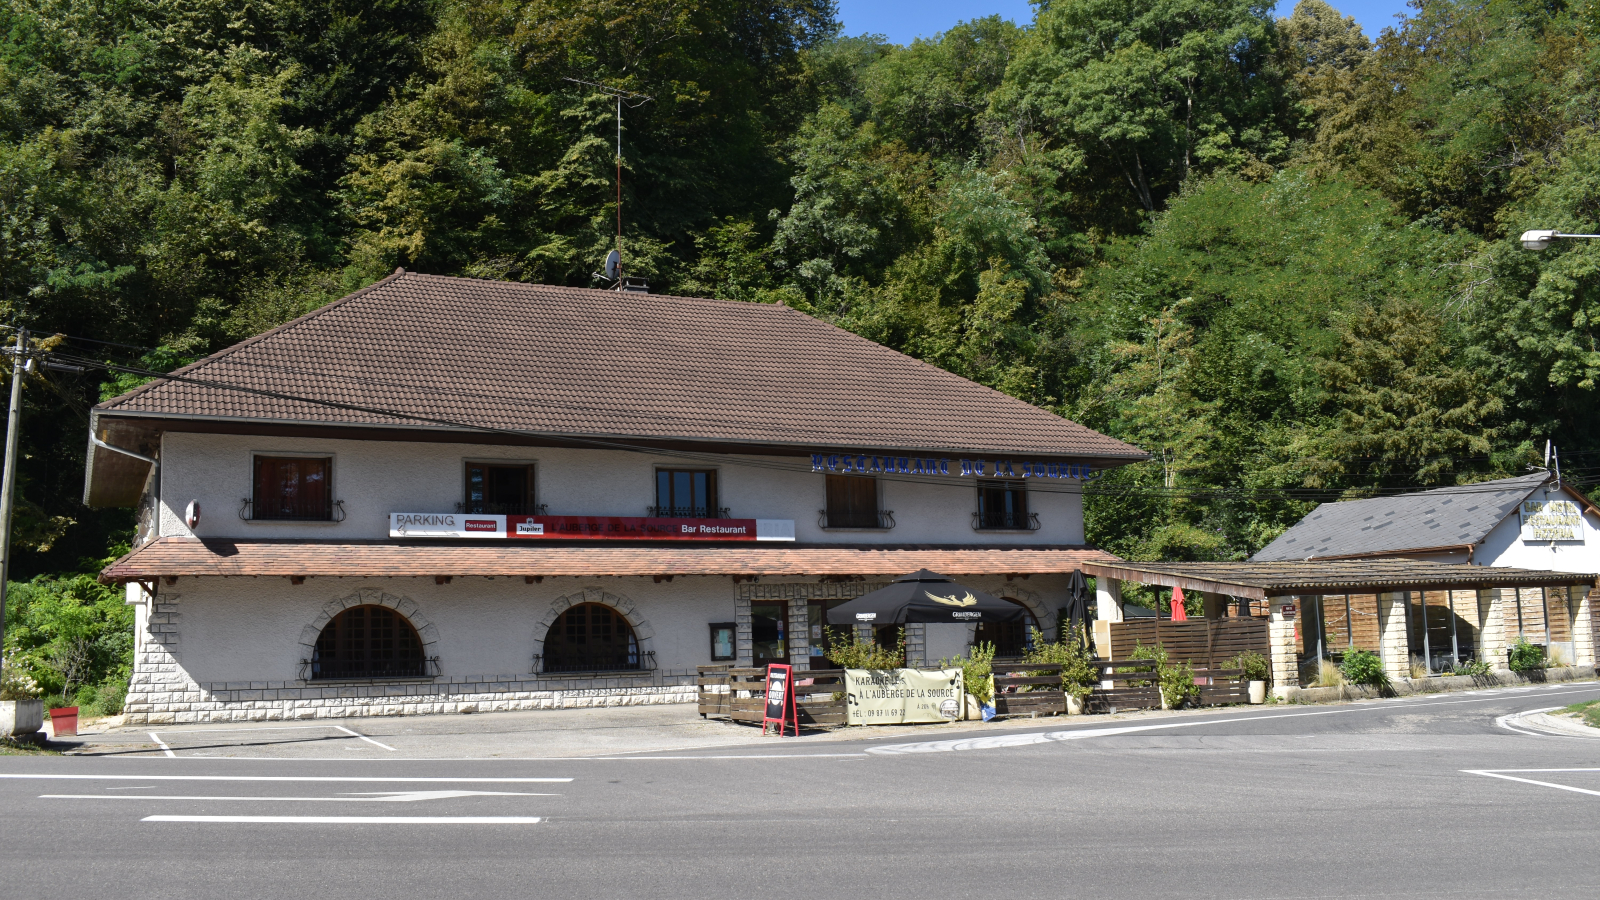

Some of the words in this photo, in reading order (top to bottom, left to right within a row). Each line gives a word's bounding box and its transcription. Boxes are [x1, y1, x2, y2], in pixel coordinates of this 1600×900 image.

[811, 454, 950, 474] RESTAURANT
[960, 459, 985, 476] DE
[993, 460, 1015, 477] LA
[1021, 461, 1091, 480] SOURCE
[1524, 501, 1543, 513] BAR
[396, 514, 456, 526] PARKING
[1522, 514, 1580, 527] RESTAURANT
[465, 522, 497, 530] Restaurant
[519, 525, 542, 533] Jupiler
[551, 523, 603, 532] L'AUBERGE
[607, 523, 620, 532] DE
[624, 524, 636, 532] LA
[640, 524, 678, 533] SOURCE
[681, 524, 697, 533] Bar
[700, 524, 747, 534] Restaurant
[1534, 527, 1575, 539] PIZZERIA
[855, 676, 889, 686] KARAOKE
[865, 688, 905, 699] L'AUBERGE
[906, 688, 915, 698] DE
[916, 688, 925, 698] LA
[927, 688, 954, 698] SOURCE
[867, 709, 875, 717] 09
[890, 708, 898, 717] 69
[899, 708, 906, 717] 22
